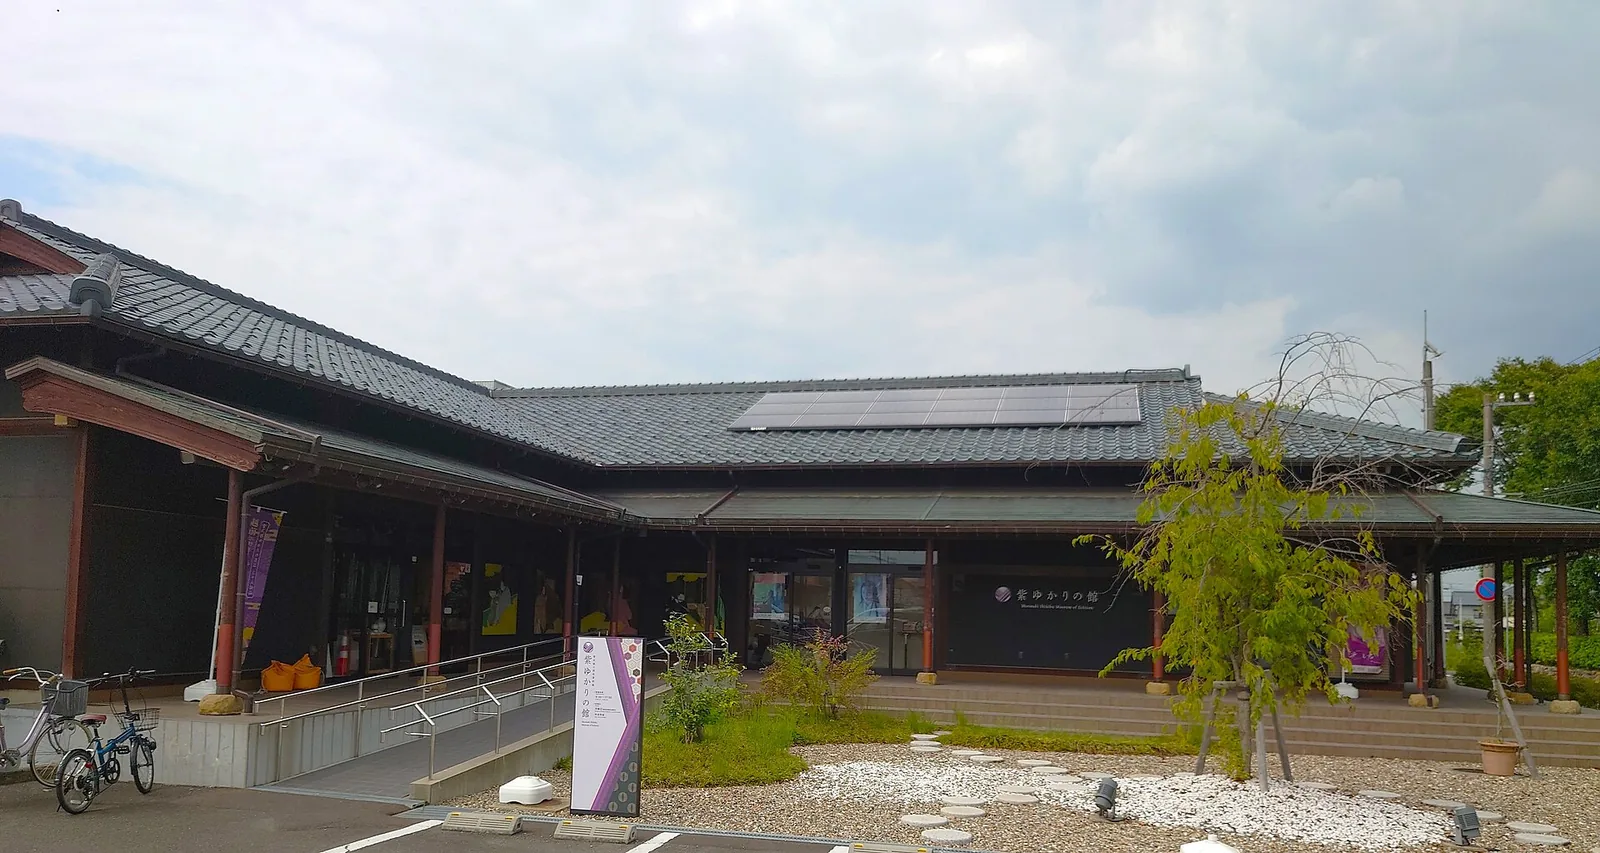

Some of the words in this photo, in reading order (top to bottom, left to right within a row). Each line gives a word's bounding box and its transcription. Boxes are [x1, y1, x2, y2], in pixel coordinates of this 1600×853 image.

[1016, 589, 1098, 602] 紫ゆかりの館
[581, 655, 592, 718] 紫ゆかりの館
